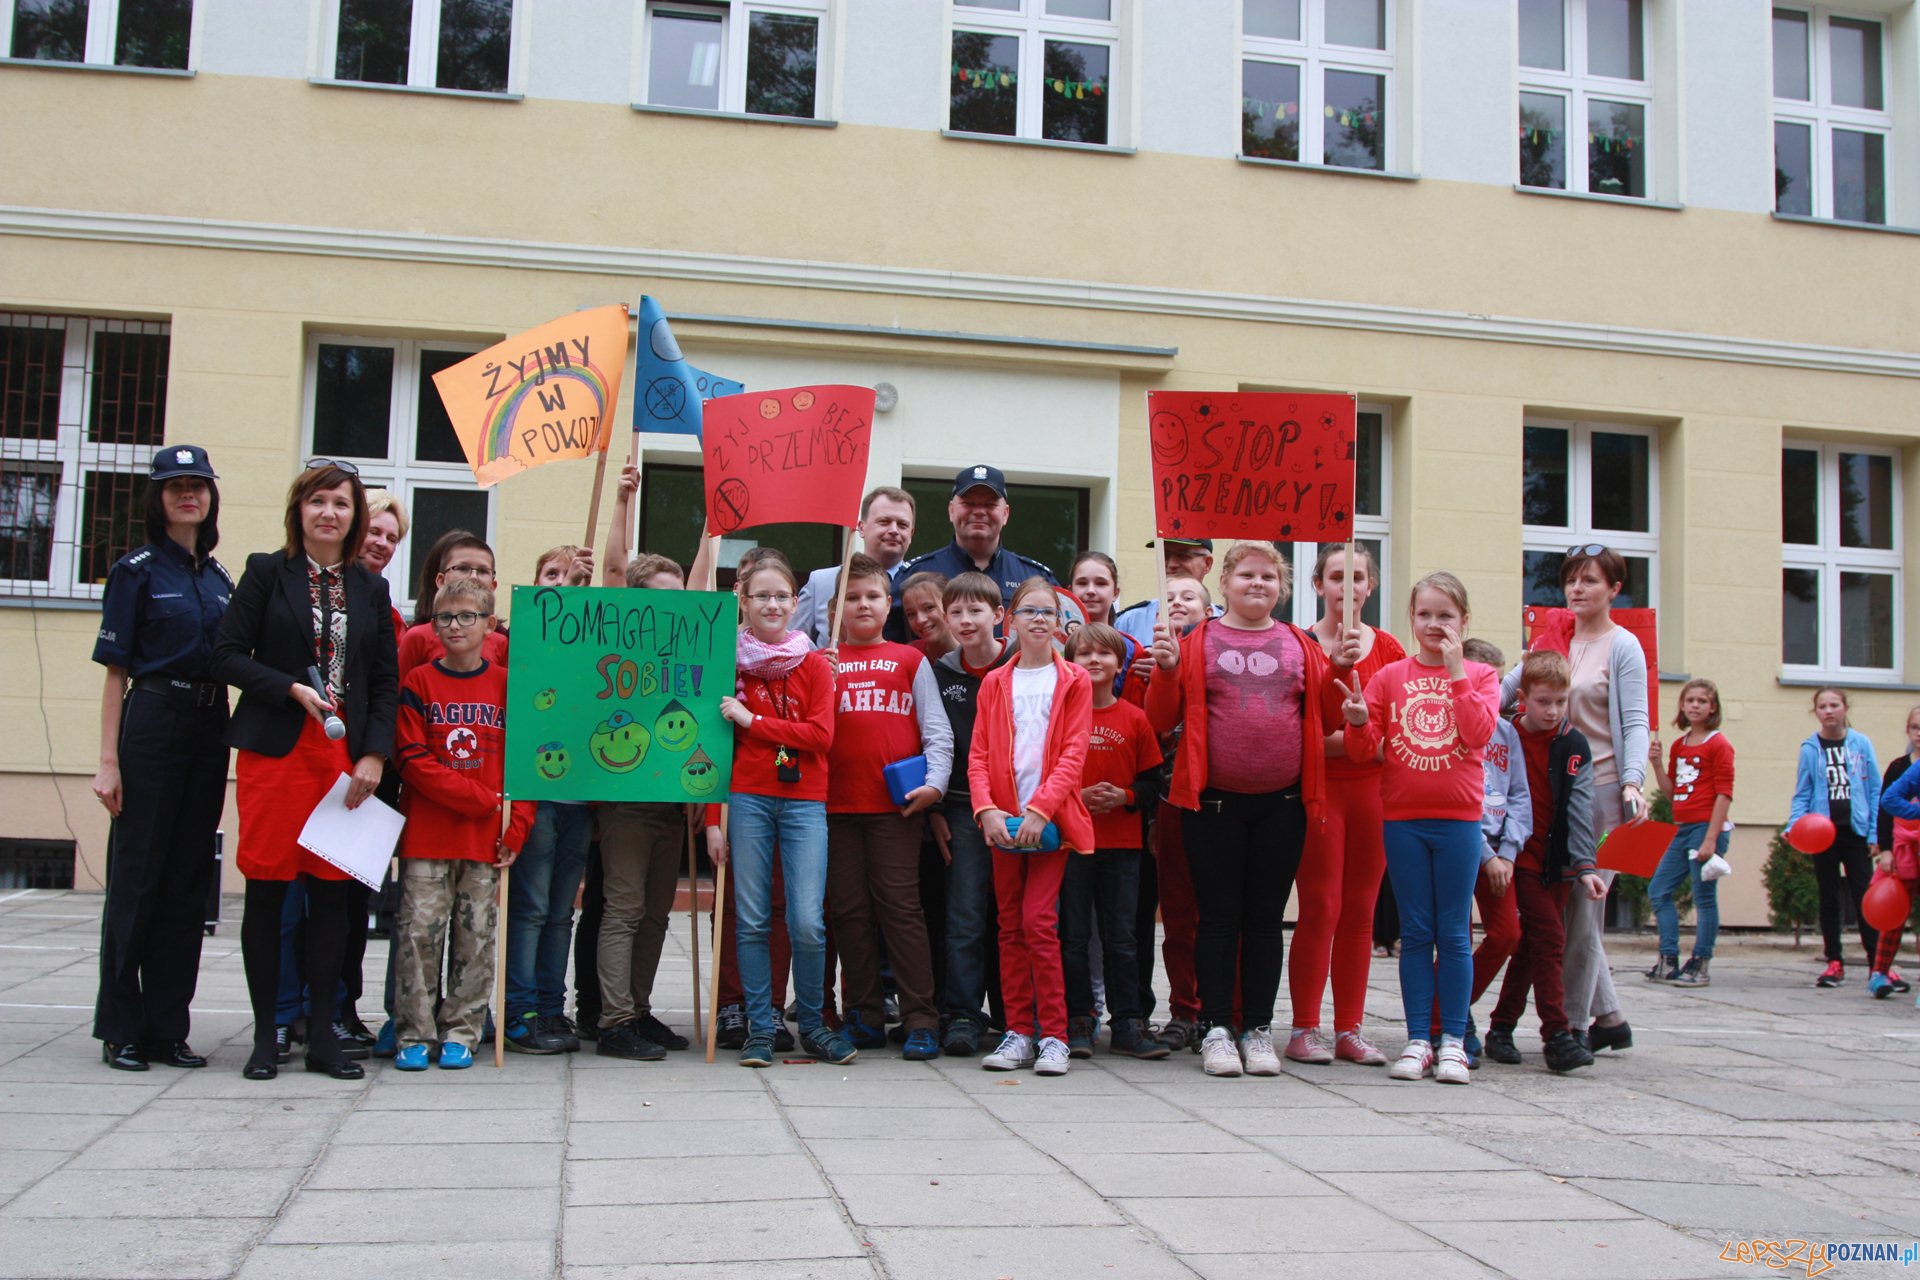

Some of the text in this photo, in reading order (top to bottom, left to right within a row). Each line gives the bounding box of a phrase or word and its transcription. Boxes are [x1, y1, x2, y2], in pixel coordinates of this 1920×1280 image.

[481, 335, 590, 401] ŻYJMY
[537, 383, 566, 413] W
[821, 402, 866, 442] BEZ
[1201, 420, 1302, 472] STOP
[533, 587, 723, 660] POMAGAJMY
[838, 658, 899, 674] ORTH EAST
[838, 688, 914, 716] AHEAD
[1390, 732, 1452, 772] WITHOUT
[1567, 754, 1582, 776] C
